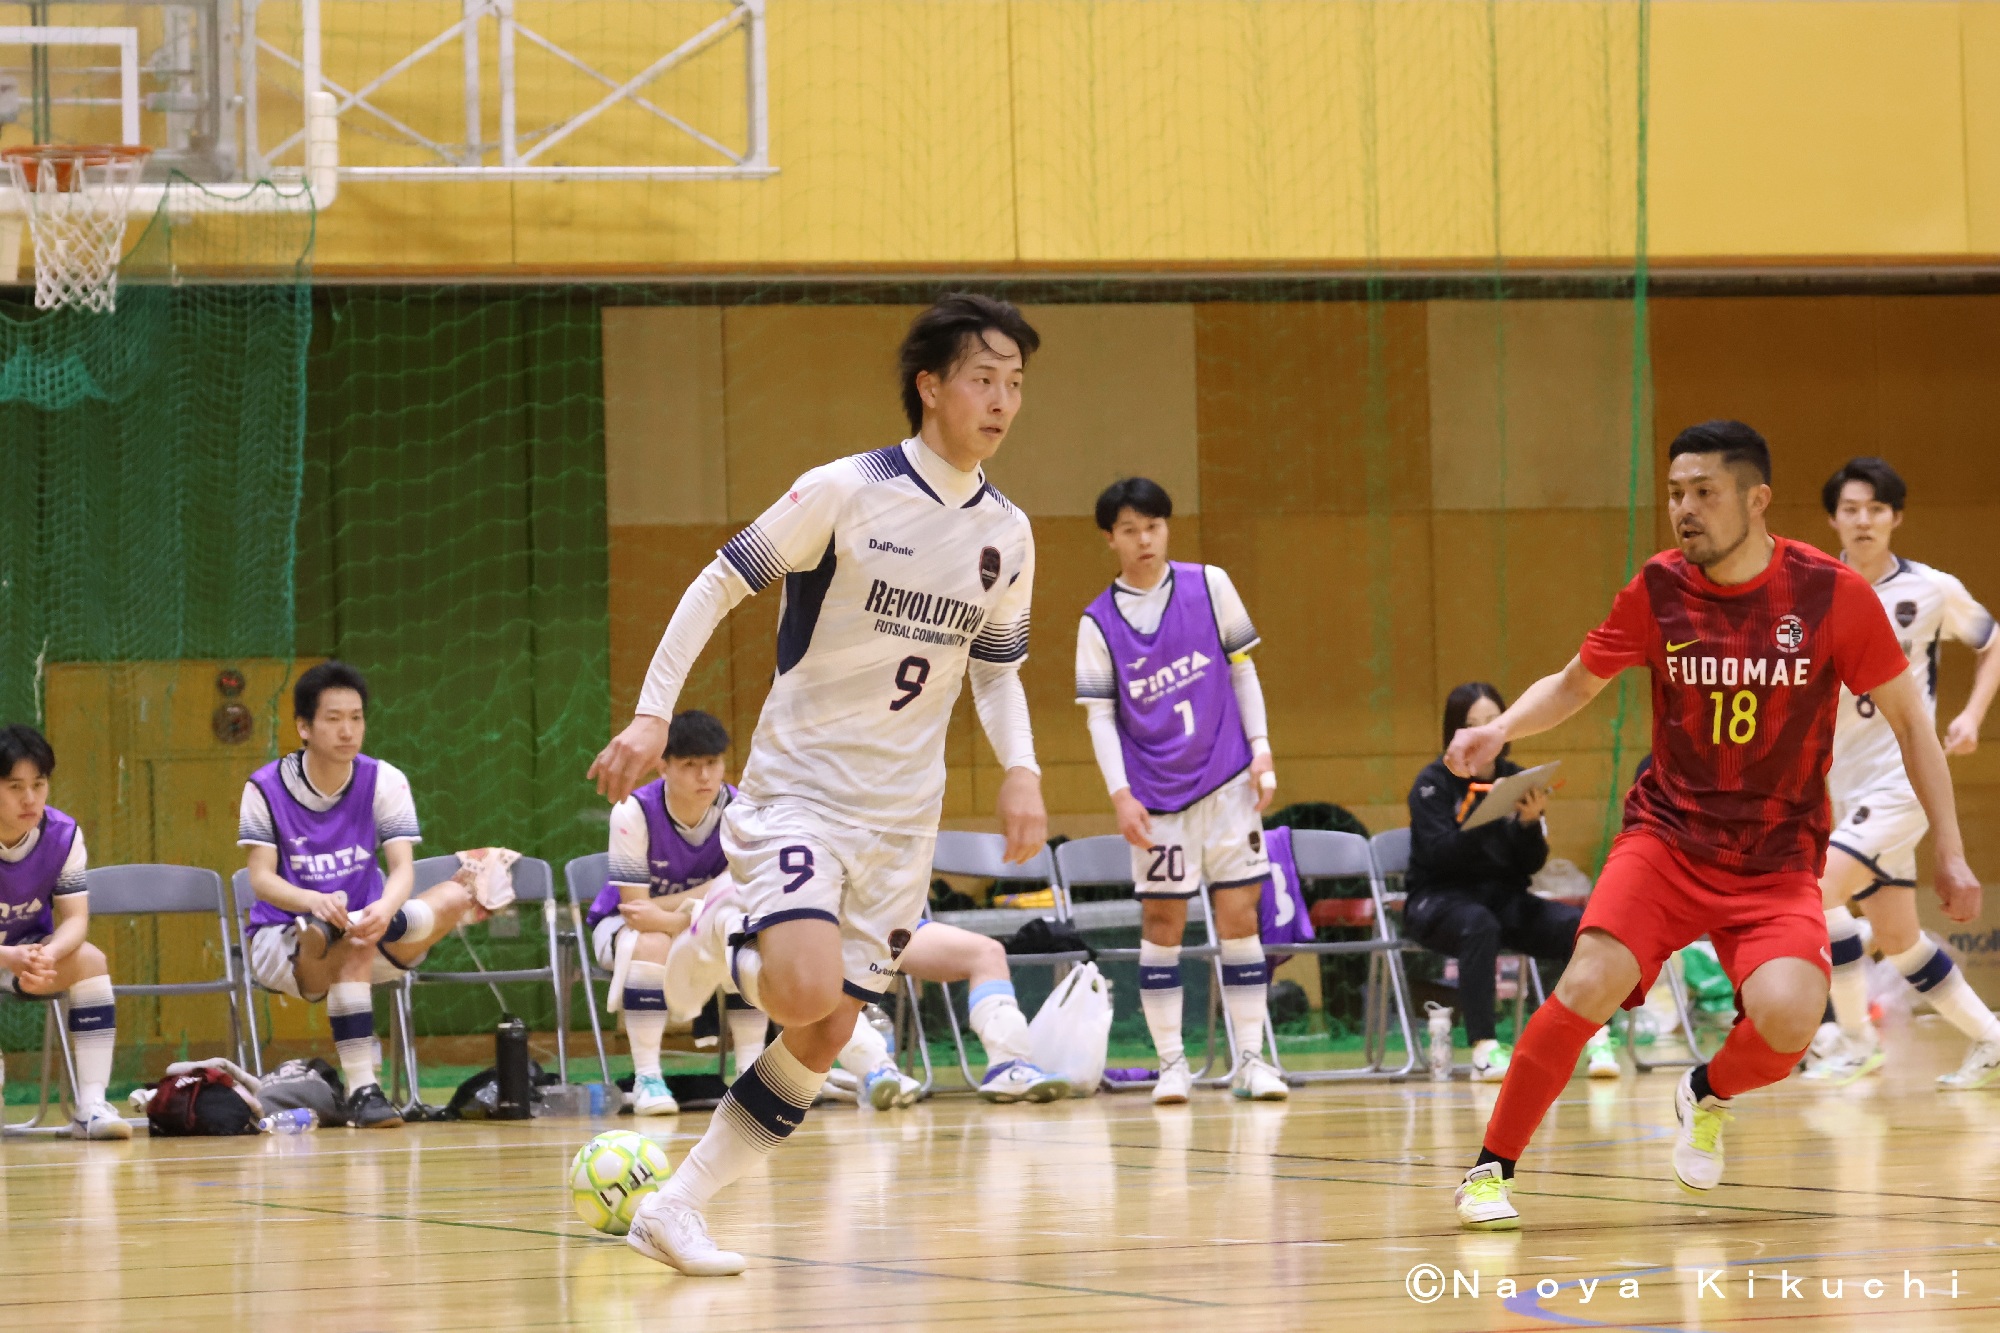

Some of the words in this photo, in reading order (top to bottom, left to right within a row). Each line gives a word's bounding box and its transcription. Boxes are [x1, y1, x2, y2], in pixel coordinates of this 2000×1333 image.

[868, 538, 914, 557] DalPonte
[864, 579, 985, 633] REVOLUTION
[874, 618, 910, 639] FUTSAL
[912, 627, 968, 647] COMMUNITY
[889, 655, 931, 711] 9
[1666, 656, 1810, 686] FUDOMAE
[1173, 700, 1195, 737] 1
[1710, 690, 1757, 744] 18
[779, 845, 814, 894] 9
[1146, 845, 1185, 881] 20
